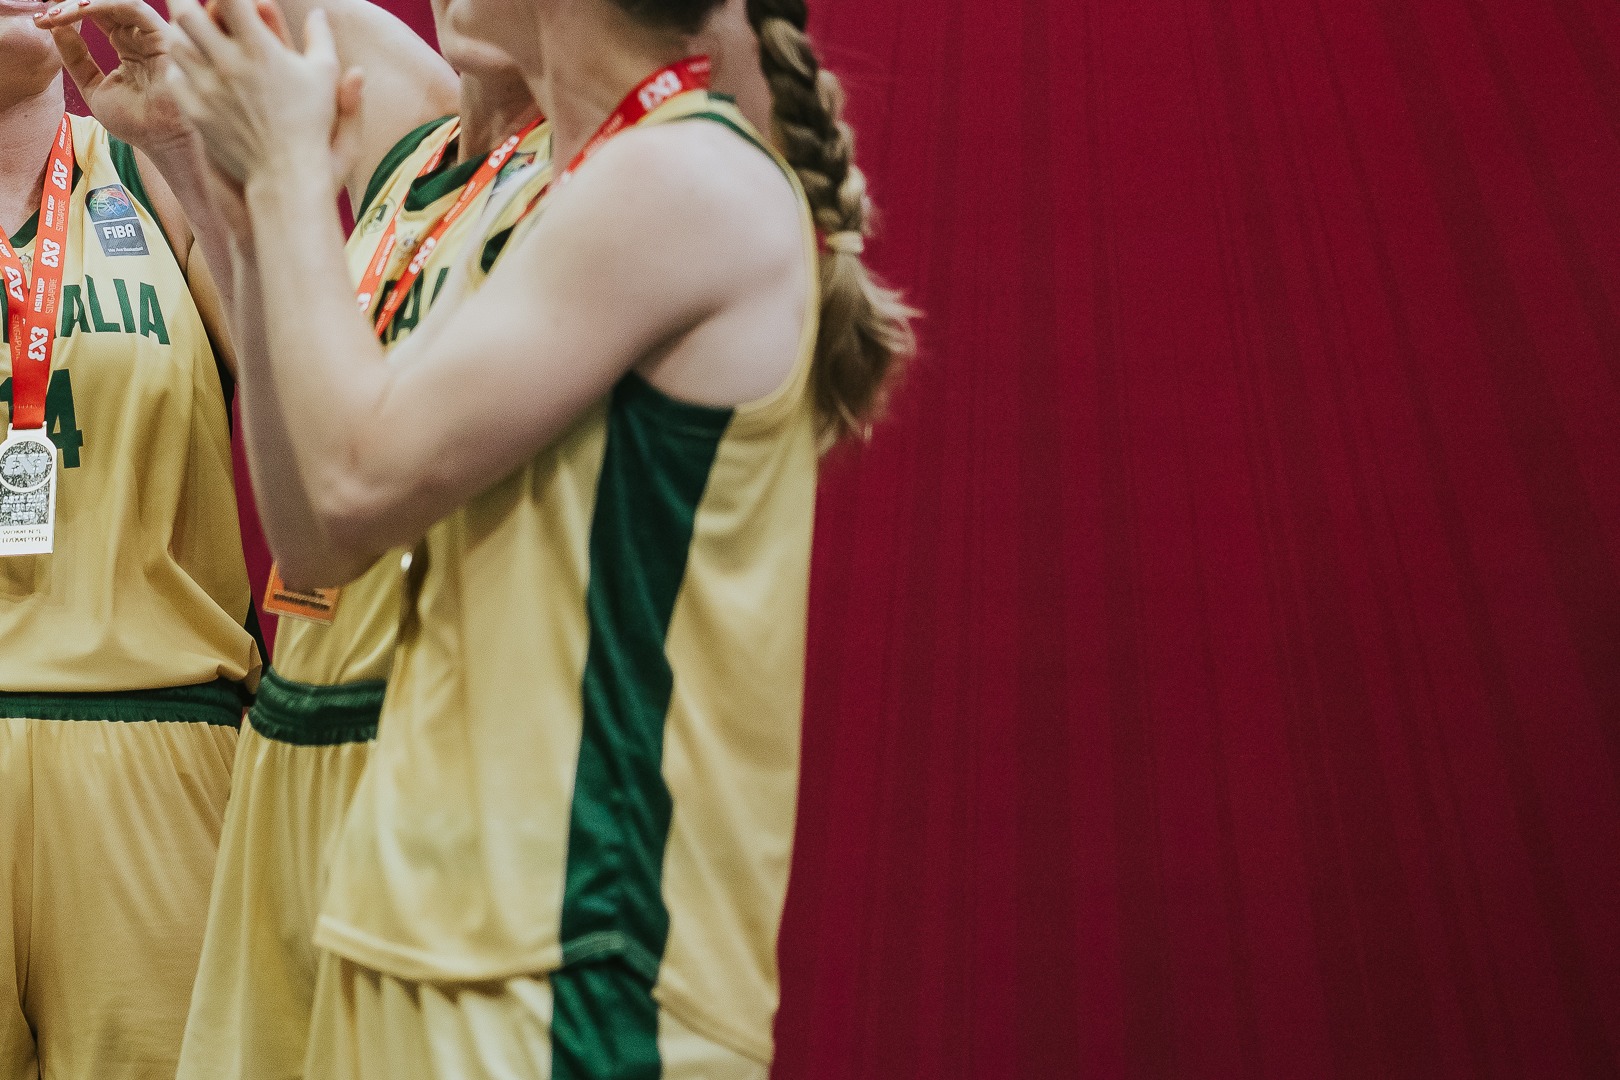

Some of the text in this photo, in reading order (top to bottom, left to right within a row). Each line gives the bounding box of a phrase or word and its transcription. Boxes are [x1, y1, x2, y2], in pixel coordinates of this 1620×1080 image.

[103, 223, 137, 239] FIBA
[34, 277, 45, 313] ASIA CUP
[45, 278, 57, 314] SINGAPORE
